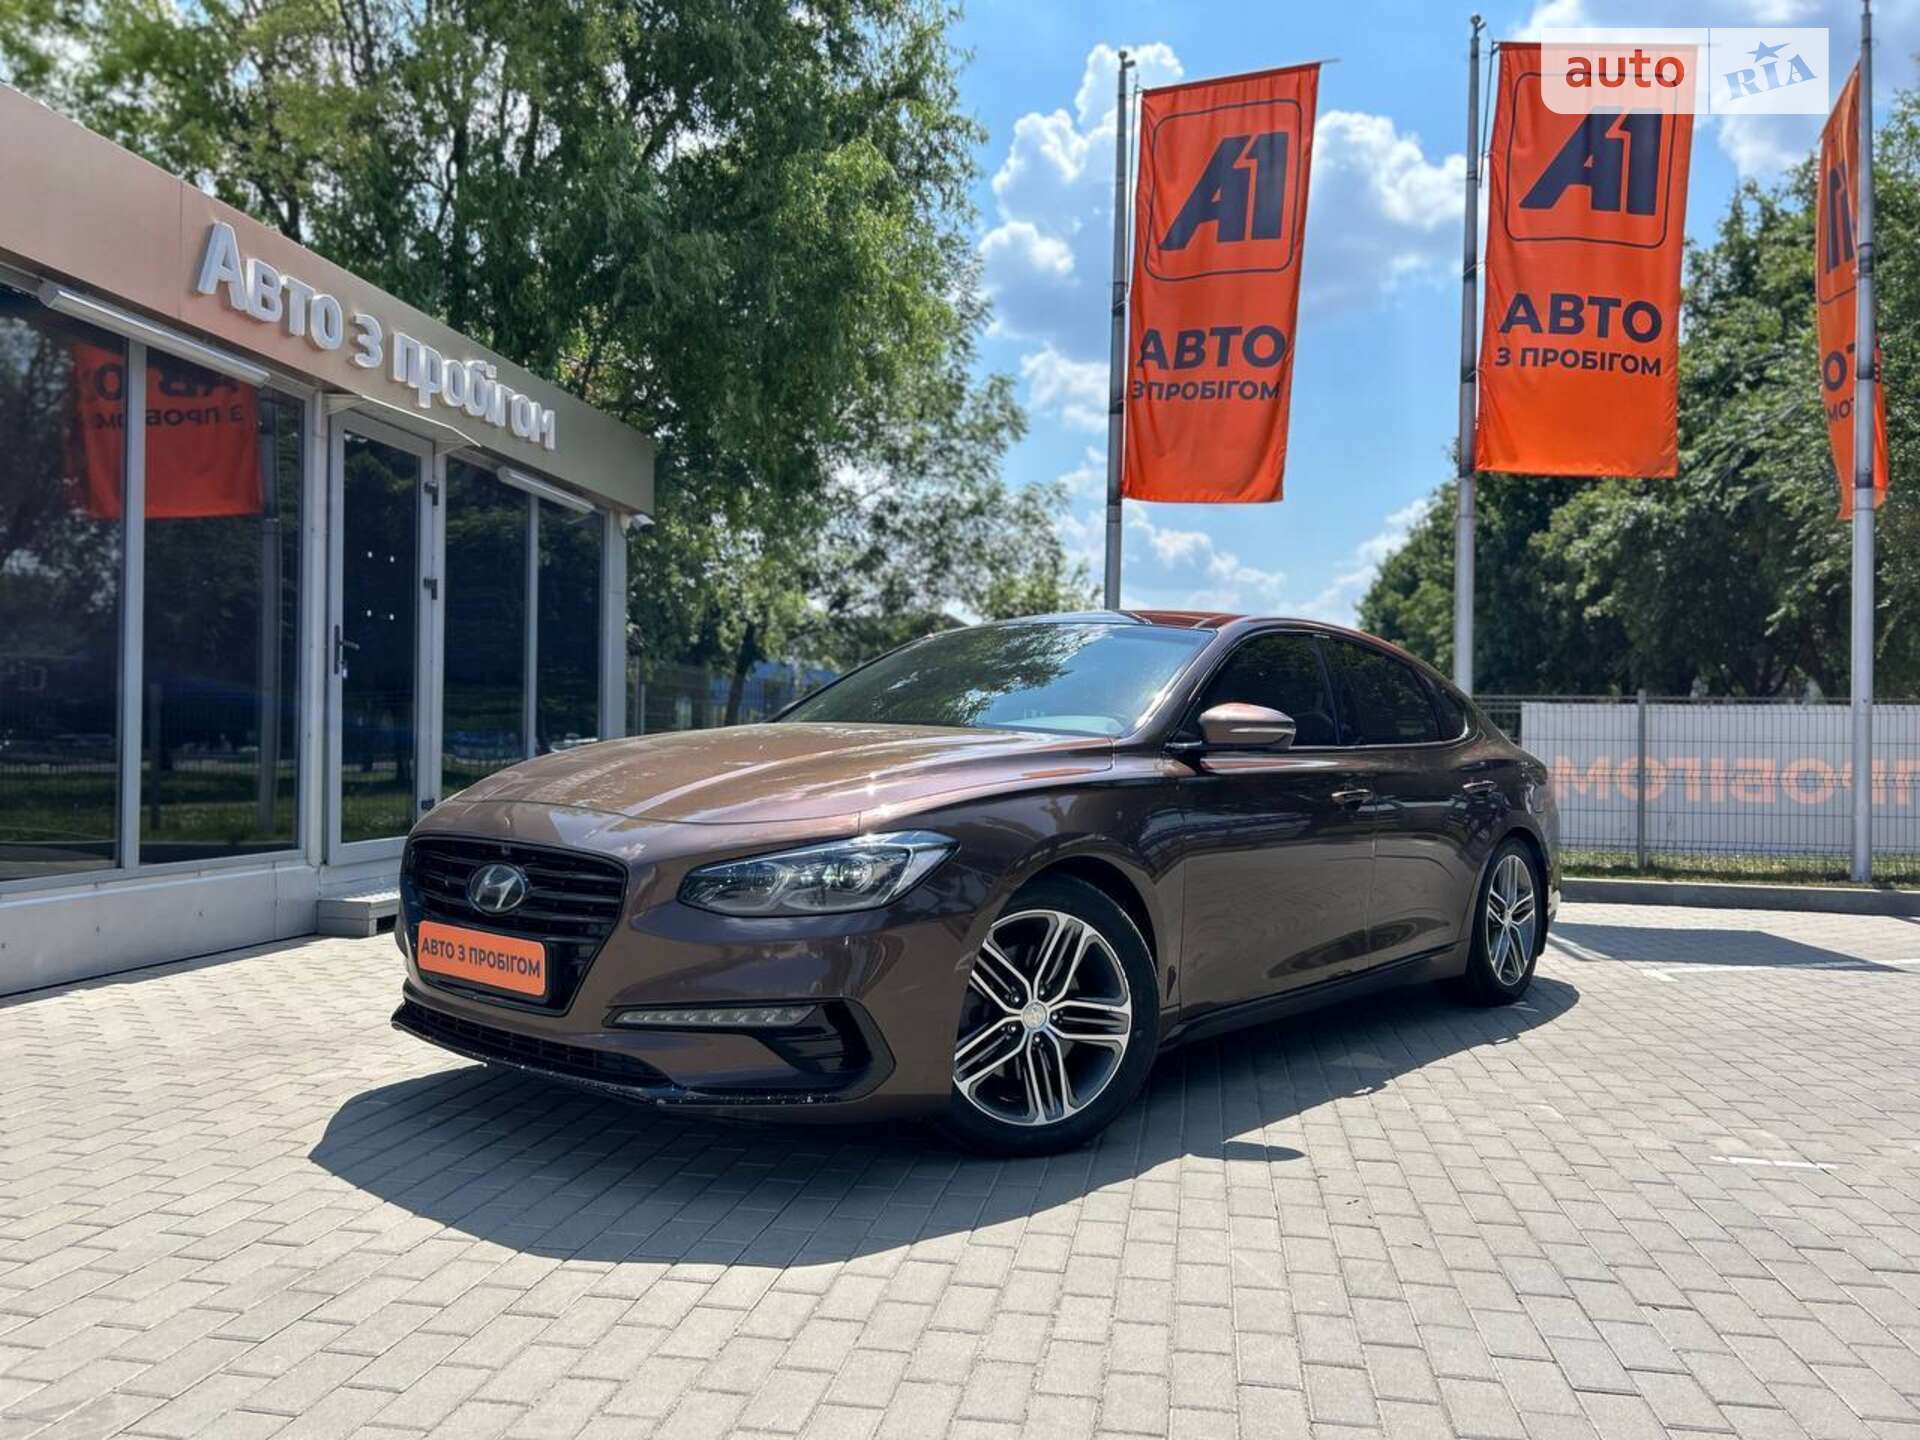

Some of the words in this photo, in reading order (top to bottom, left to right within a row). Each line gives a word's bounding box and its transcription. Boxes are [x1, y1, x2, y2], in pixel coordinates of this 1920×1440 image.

[197, 220, 345, 351] Авто
[392, 331, 556, 451] пробігом
[1497, 292, 1663, 343] АВТО
[1136, 324, 1288, 371] АВТО
[1494, 347, 1512, 367] З
[1519, 347, 1662, 377] ПРОБІГОМ
[1132, 379, 1144, 399] З
[1148, 380, 1282, 401] ПРОБІГОМ
[422, 937, 455, 960] АВТО
[458, 943, 467, 963] З
[469, 947, 541, 978] ПРОБІГОМ
